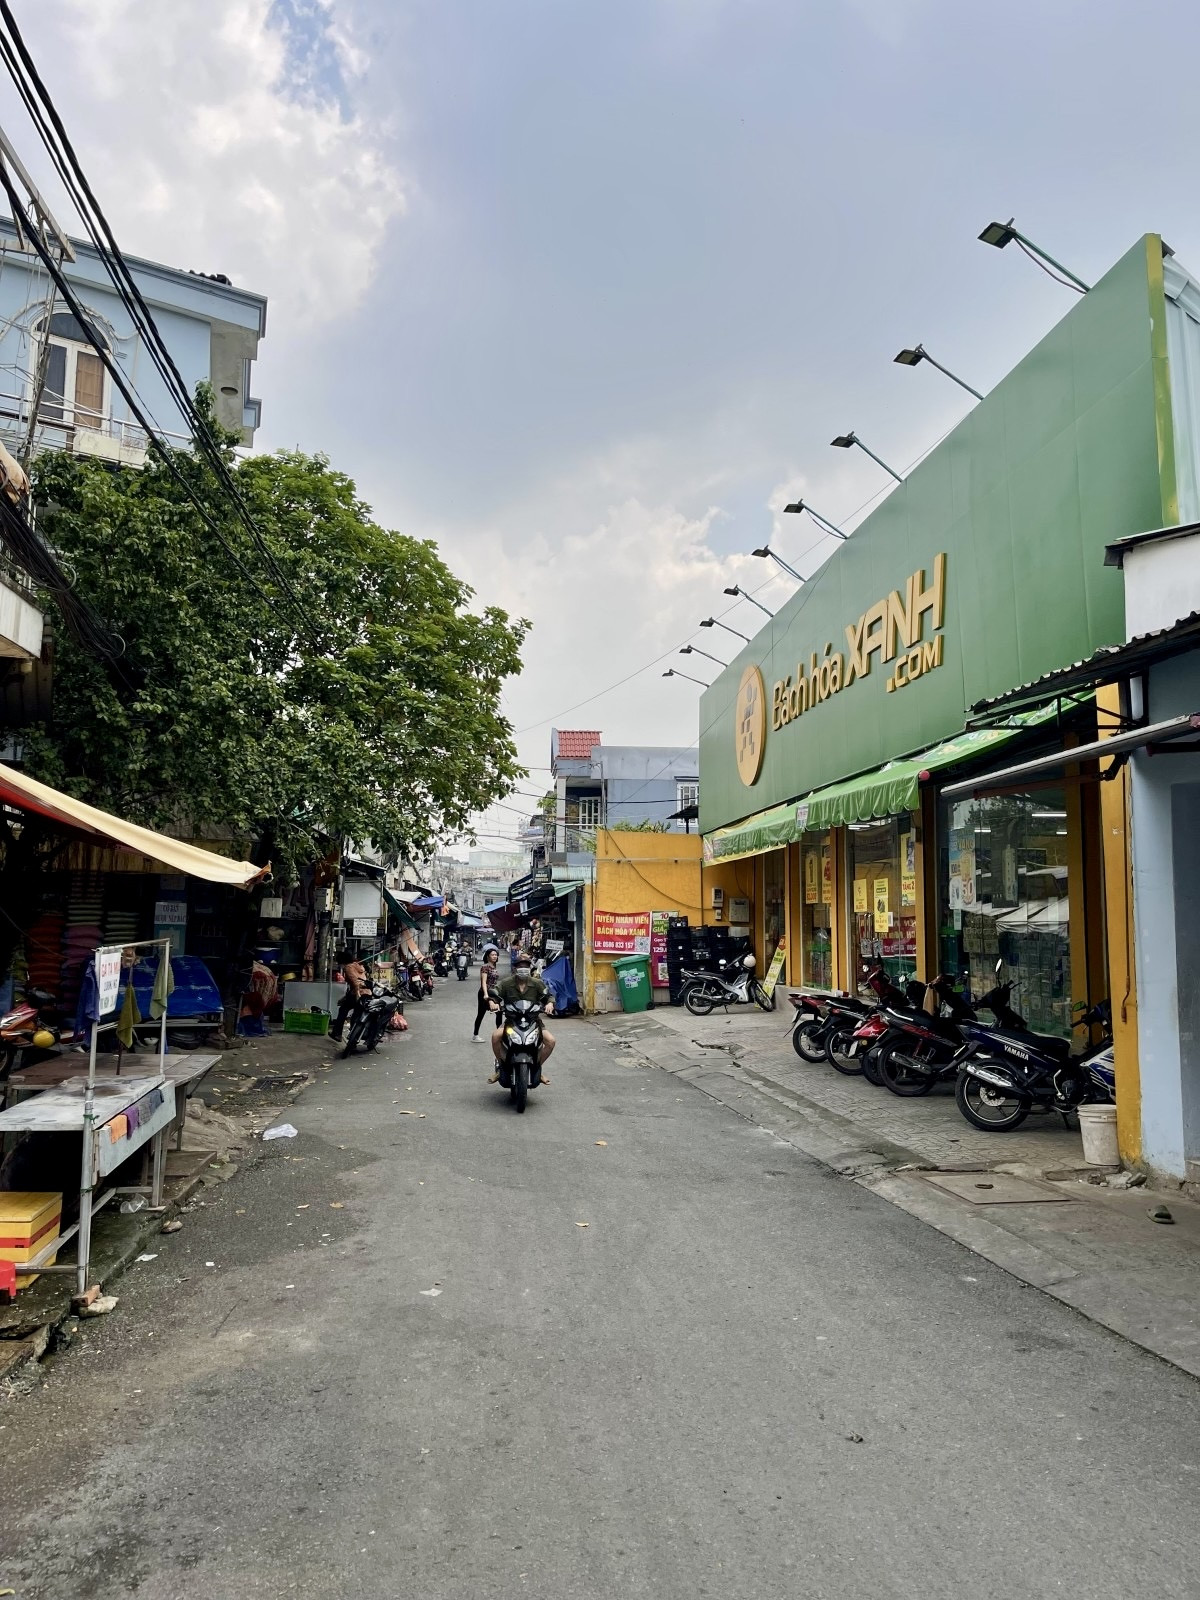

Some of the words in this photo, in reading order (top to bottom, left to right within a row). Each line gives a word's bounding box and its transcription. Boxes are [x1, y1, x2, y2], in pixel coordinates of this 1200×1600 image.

[772, 663, 808, 731] Bách
[809, 642, 843, 708] hóa
[844, 552, 945, 687] XANH
[886, 635, 944, 693] .COM
[597, 925, 614, 935] BÁCH
[628, 928, 646, 936] XANH
[1004, 1044, 1029, 1060] YAMAHA
